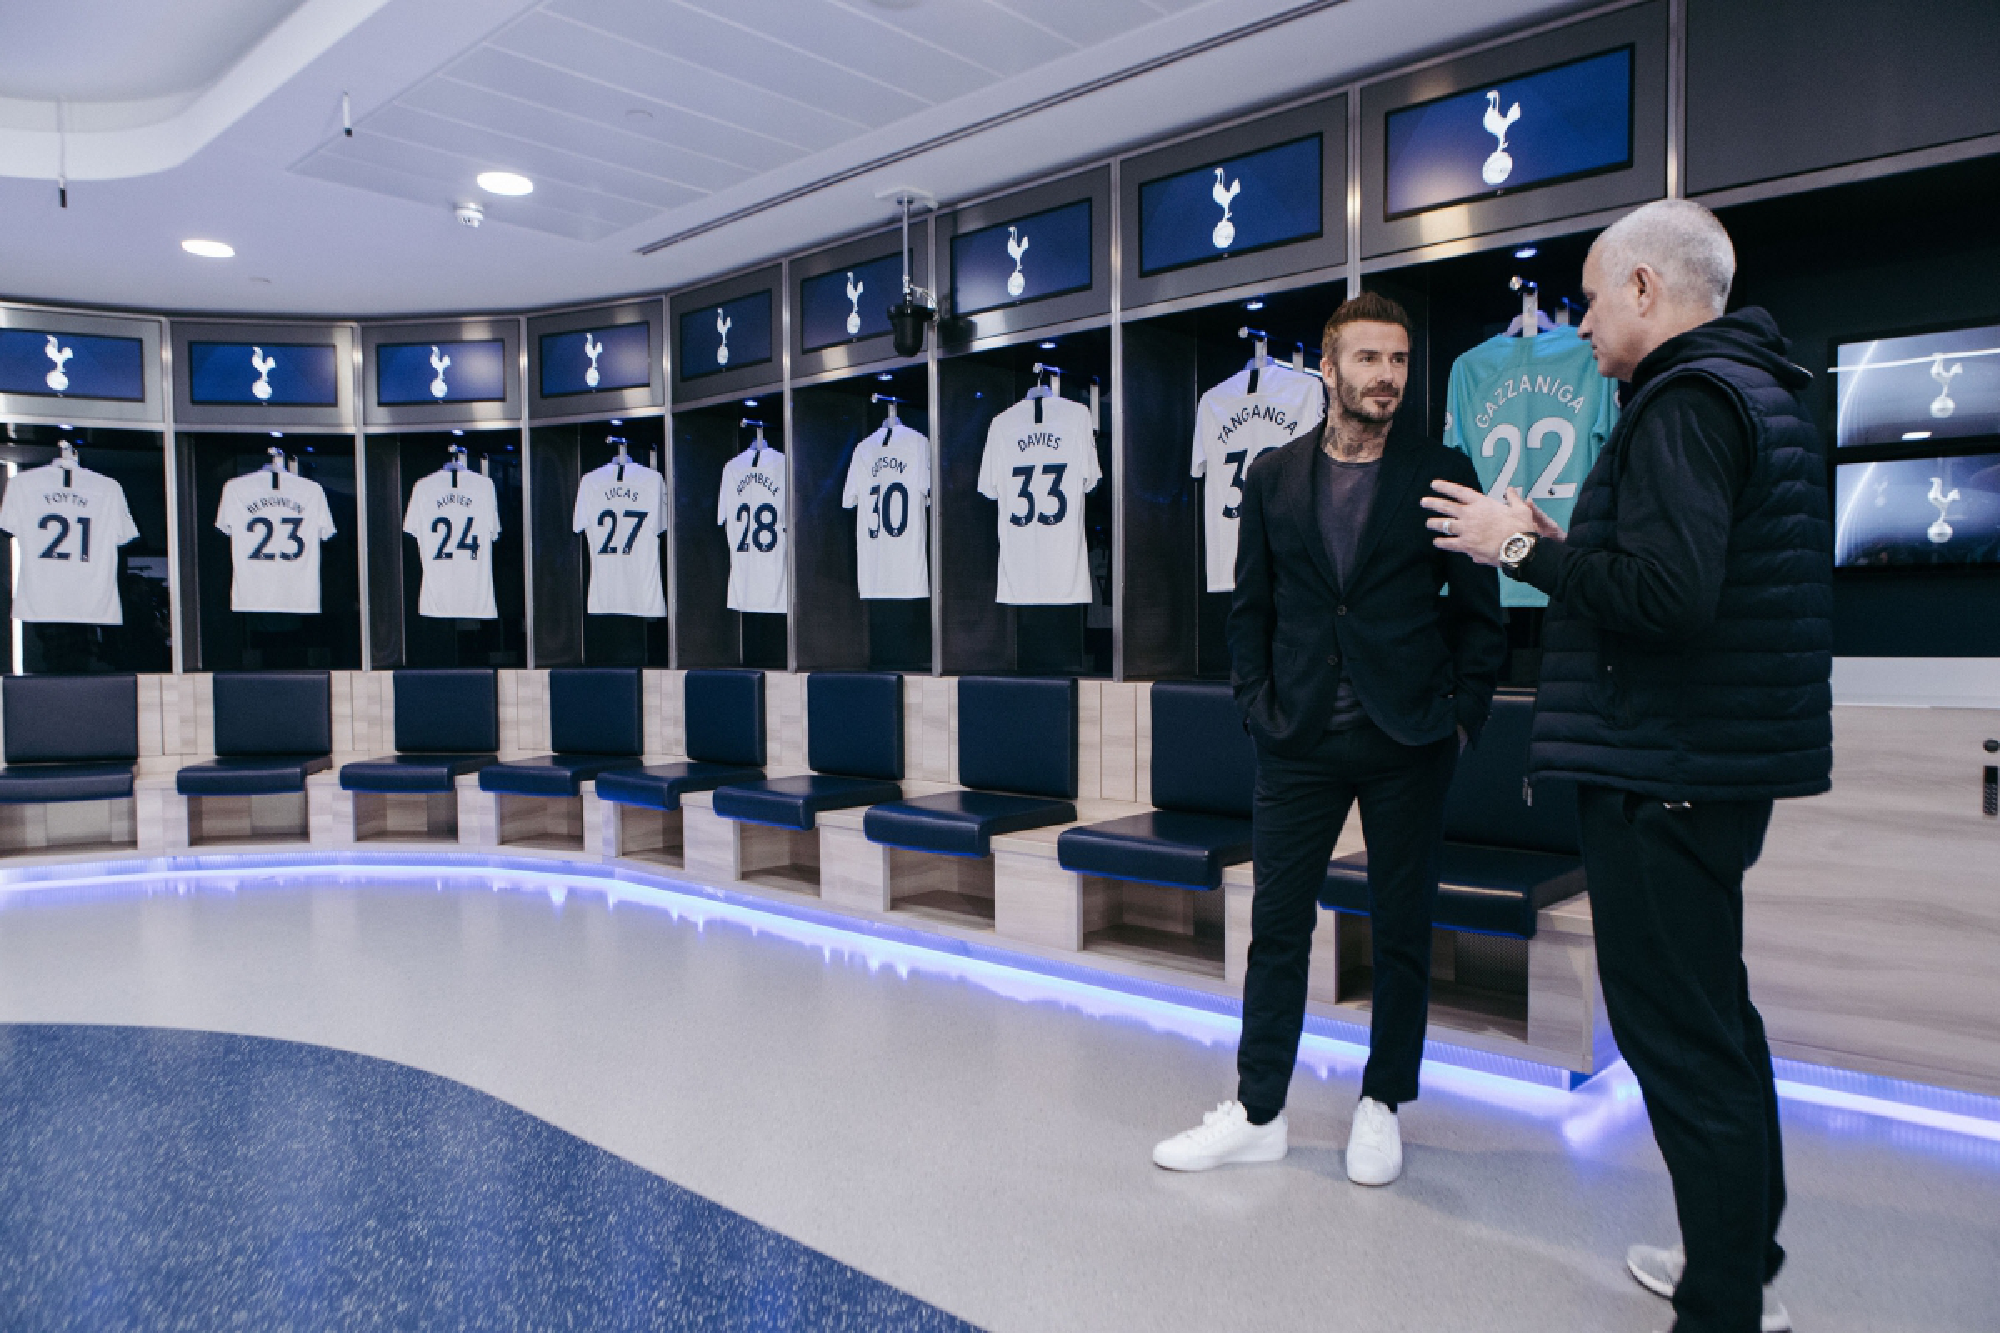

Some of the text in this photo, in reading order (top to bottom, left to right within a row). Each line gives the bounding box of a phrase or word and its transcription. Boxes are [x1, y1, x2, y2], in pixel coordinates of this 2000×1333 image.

[1217, 404, 1298, 445] TANGANGA
[1476, 374, 1586, 429] GAZZANIGA
[1017, 432, 1063, 452] DAVIES
[1481, 416, 1578, 503] 22
[604, 487, 639, 502] LUCAS
[1009, 463, 1068, 527] 33
[1222, 446, 1284, 519] 3
[597, 509, 649, 555] 27
[736, 503, 778, 552] 28
[868, 482, 909, 539] 30
[38, 513, 92, 562] 21
[246, 517, 305, 560] 23
[431, 516, 480, 560] 24
